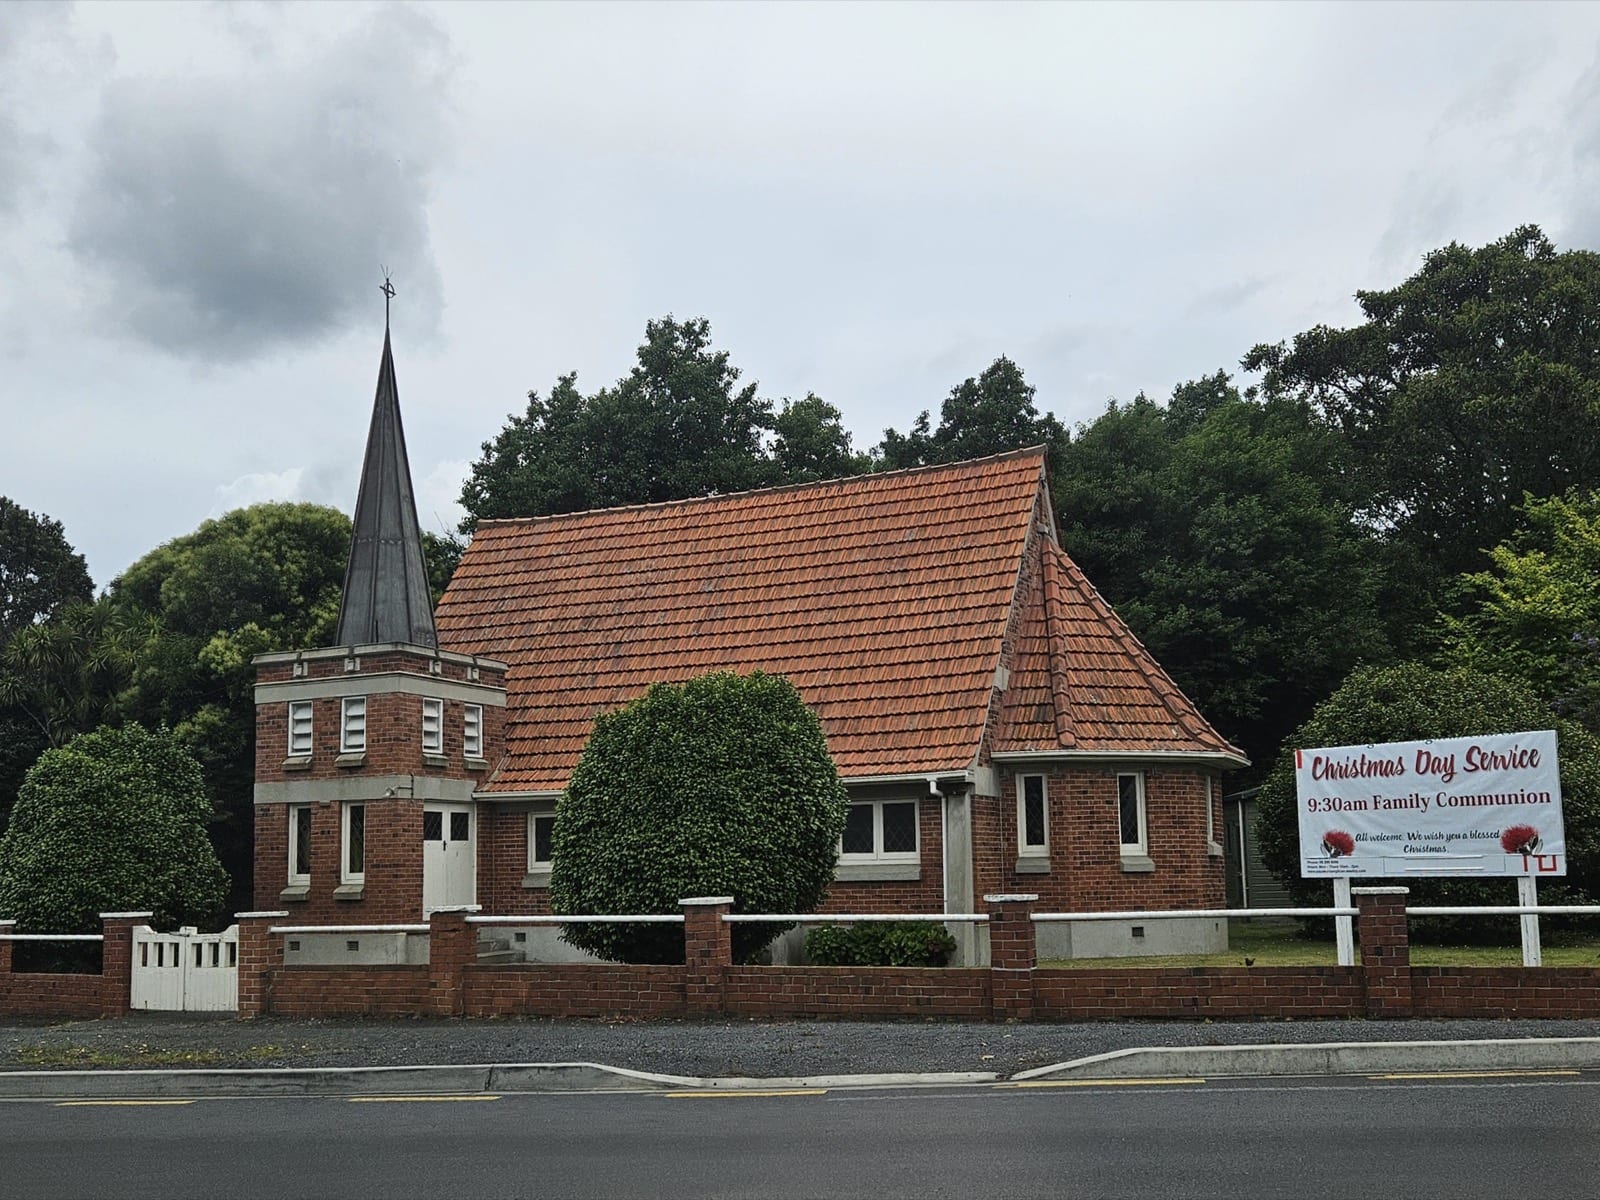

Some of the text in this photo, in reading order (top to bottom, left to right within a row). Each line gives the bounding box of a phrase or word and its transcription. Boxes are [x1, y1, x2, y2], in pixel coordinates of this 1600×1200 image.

[1312, 744, 1541, 783] Christmas Day Service
[1308, 788, 1552, 813] 9:30am Family Communion
[1355, 832, 1368, 842] All
[1407, 831, 1423, 841] We
[1424, 831, 1444, 841] wish
[1445, 833, 1461, 843] you
[1469, 829, 1500, 840] blessed
